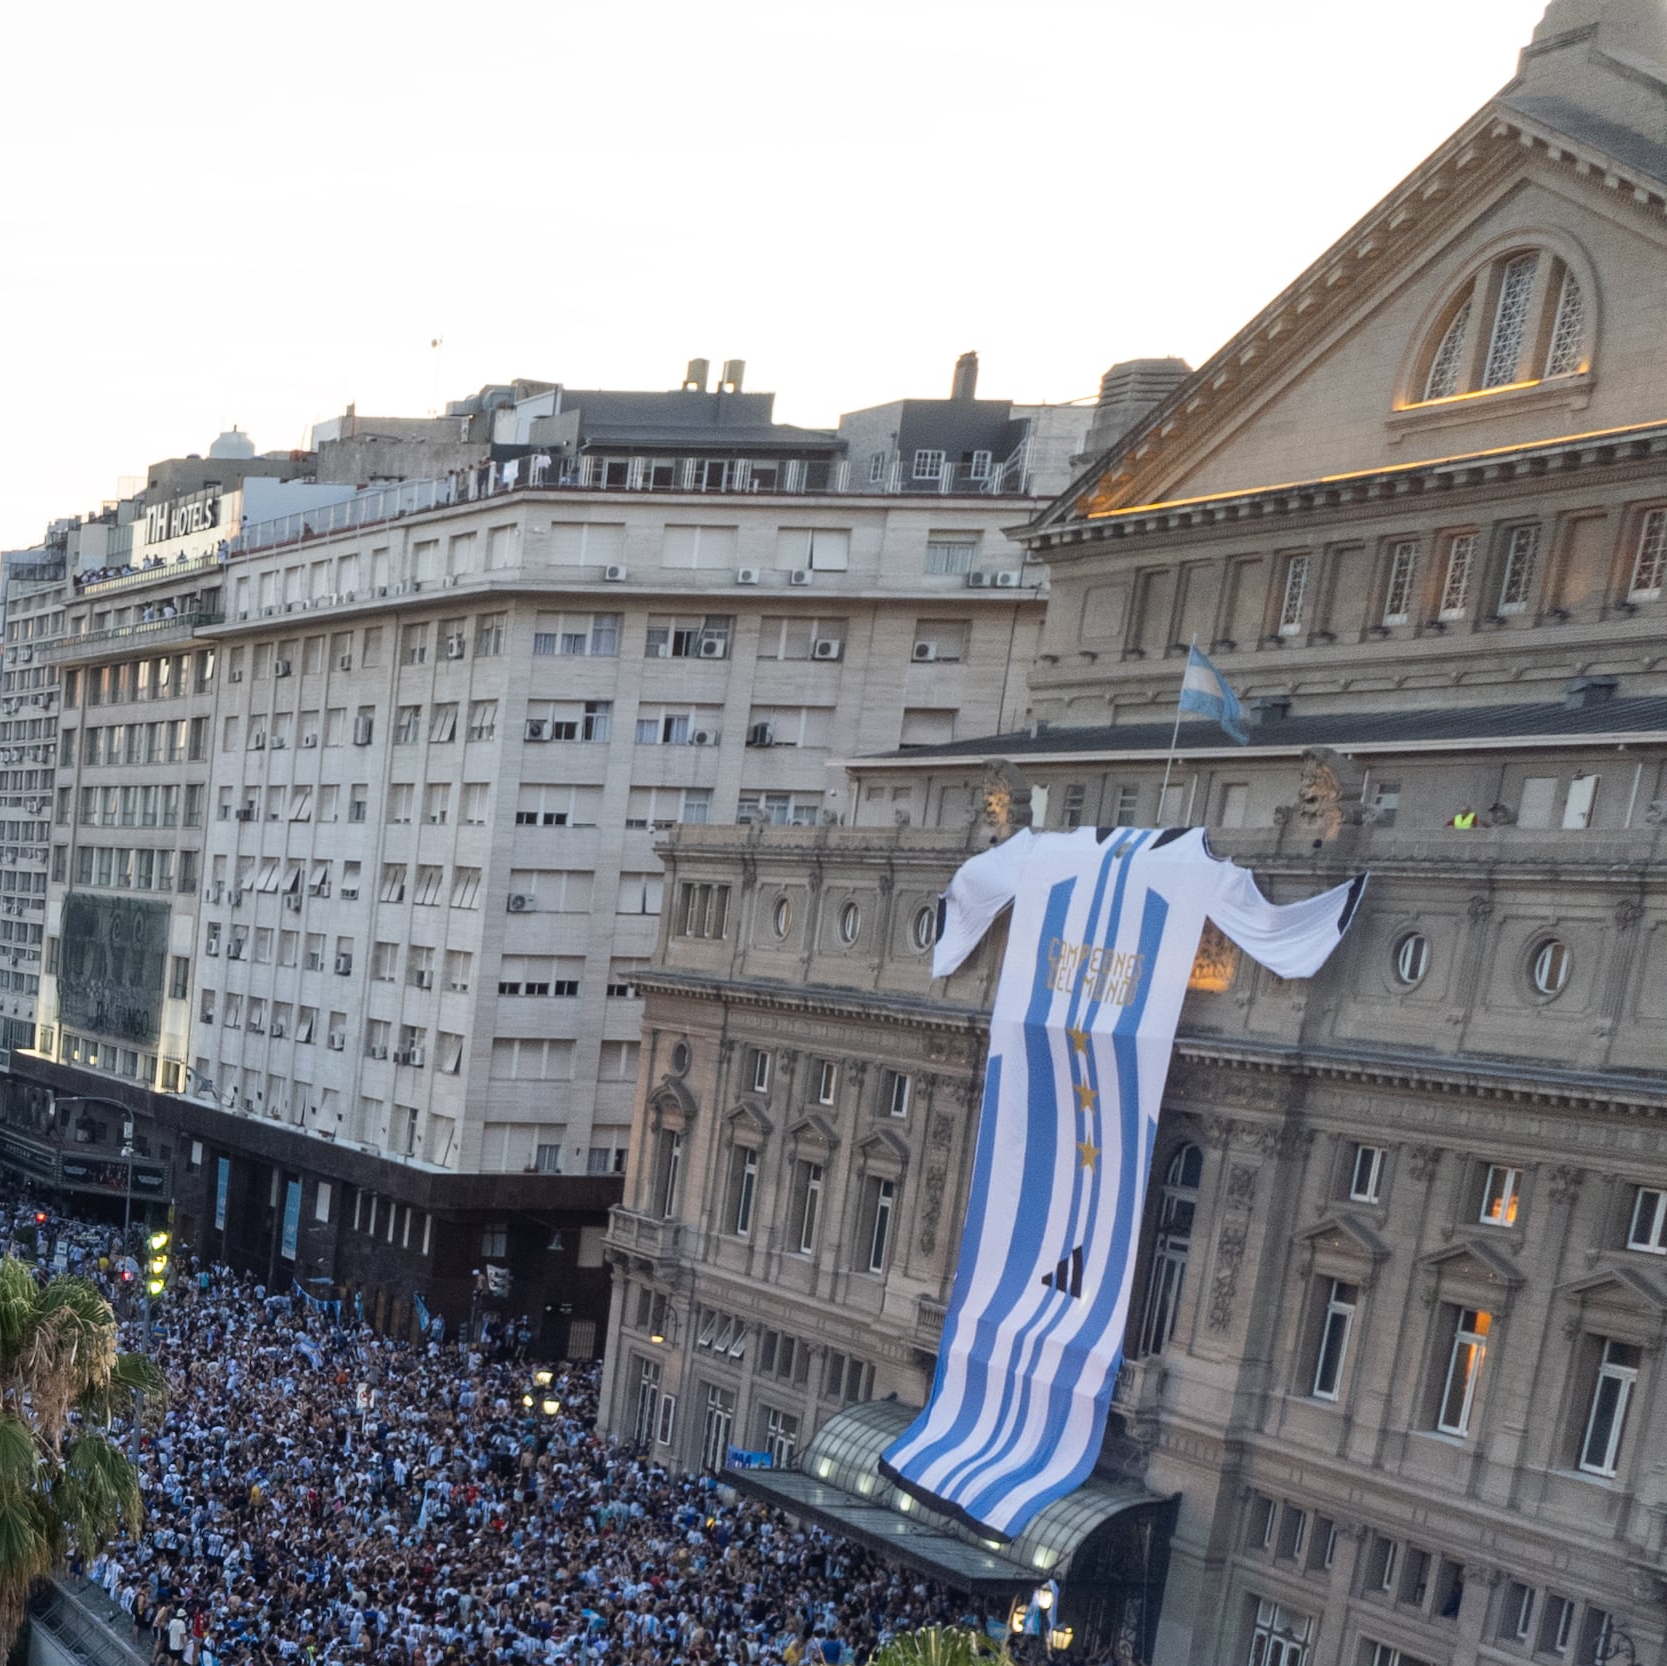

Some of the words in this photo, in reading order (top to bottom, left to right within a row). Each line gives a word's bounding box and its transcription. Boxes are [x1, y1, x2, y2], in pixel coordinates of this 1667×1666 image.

[170, 497, 213, 539] HOTELS
[1048, 936, 1146, 981] CAMPEONES
[1046, 964, 1073, 993] DEL
[1080, 975, 1138, 1007] MUNDO
